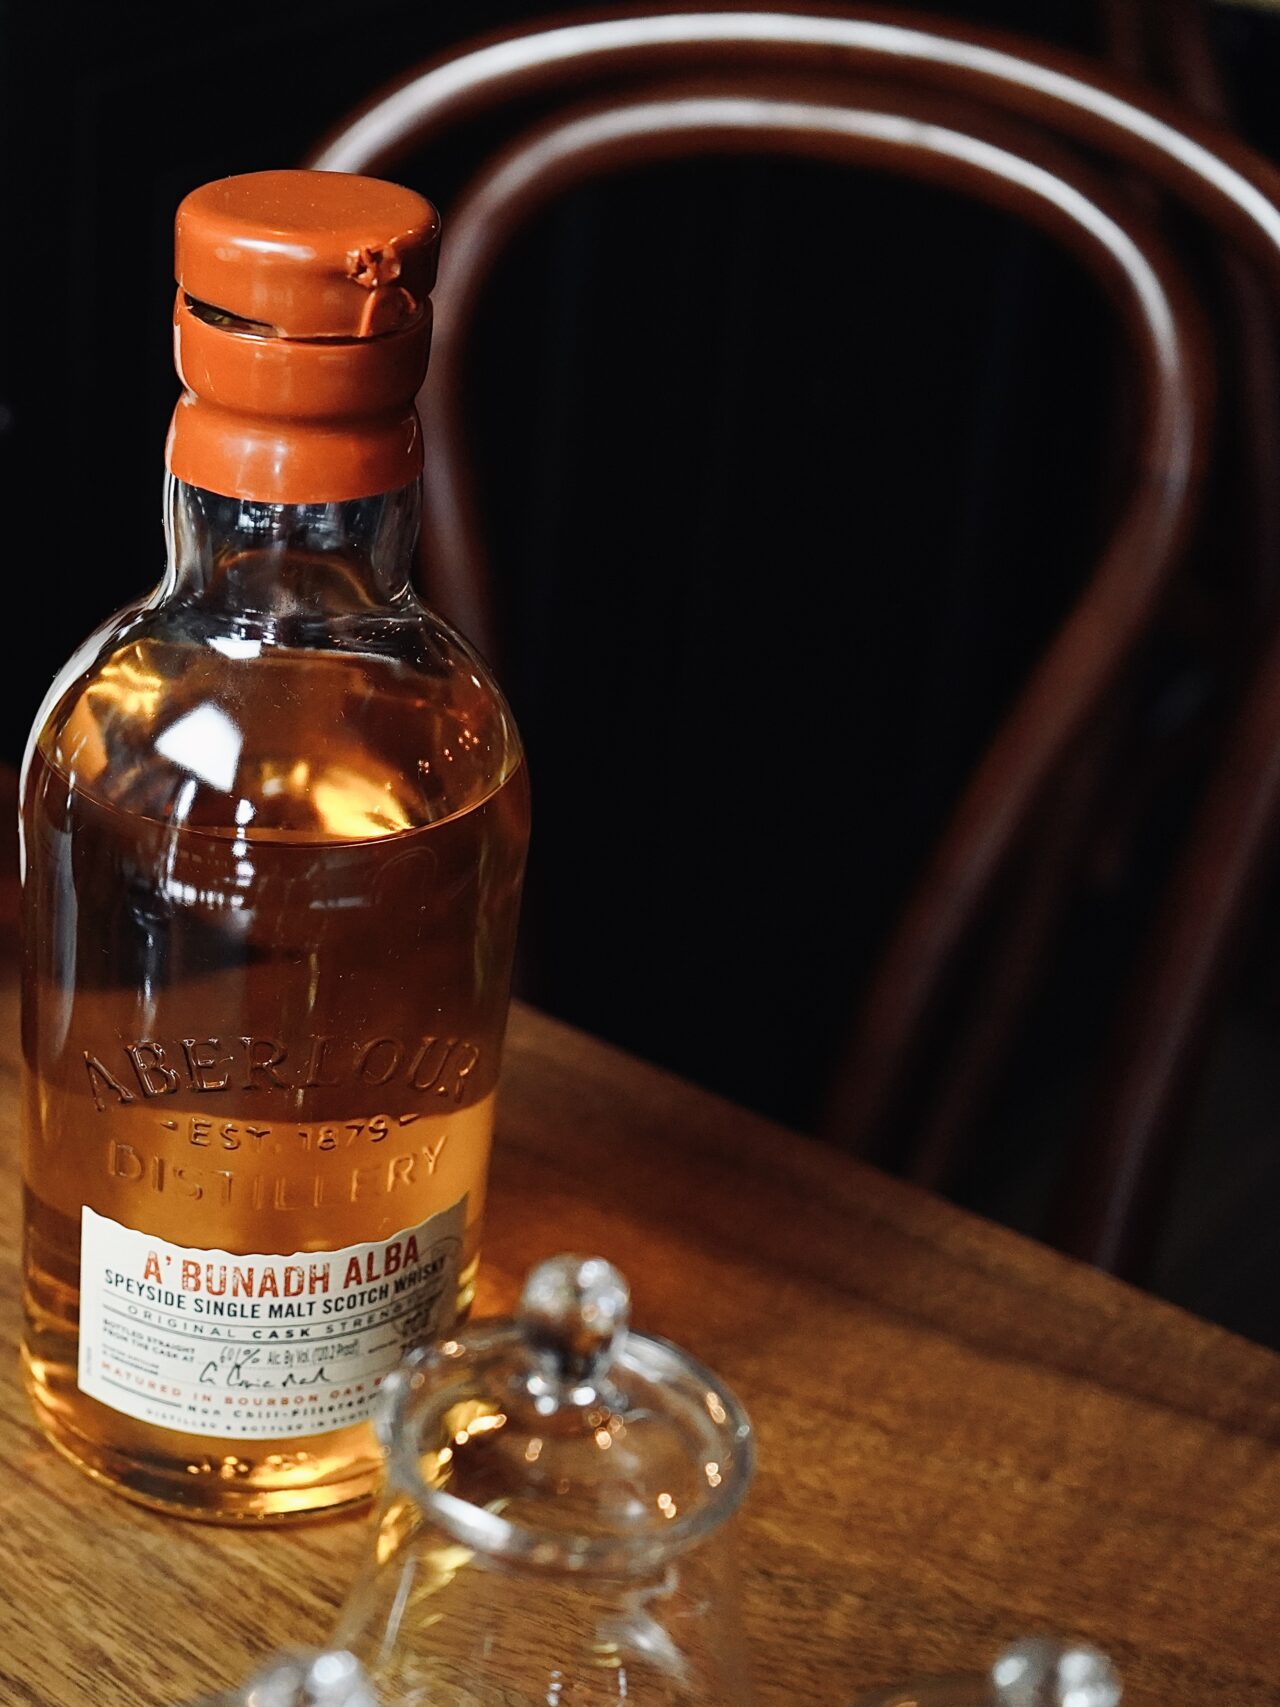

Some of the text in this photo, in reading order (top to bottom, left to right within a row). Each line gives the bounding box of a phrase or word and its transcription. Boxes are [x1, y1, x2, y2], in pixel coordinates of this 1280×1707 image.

[83, 1035, 480, 1113] ABERLOUR
[297, 1113, 390, 1151] 1879
[106, 1135, 449, 1211] DISTILLERY
[104, 1254, 447, 1319] SPEYSIDE SINGLE MALT SCOTCH WHISKY
[342, 1234, 420, 1290] ALBA
[127, 1304, 238, 1339] ORIGINAL
[252, 1327, 311, 1340] CASK
[152, 1345, 180, 1360] CASK
[182, 1353, 195, 1364] AT
[101, 1361, 182, 1397] MATURED
[192, 1391, 213, 1403] IN
[224, 1393, 319, 1406] BOURBON
[329, 1383, 366, 1400] OAK
